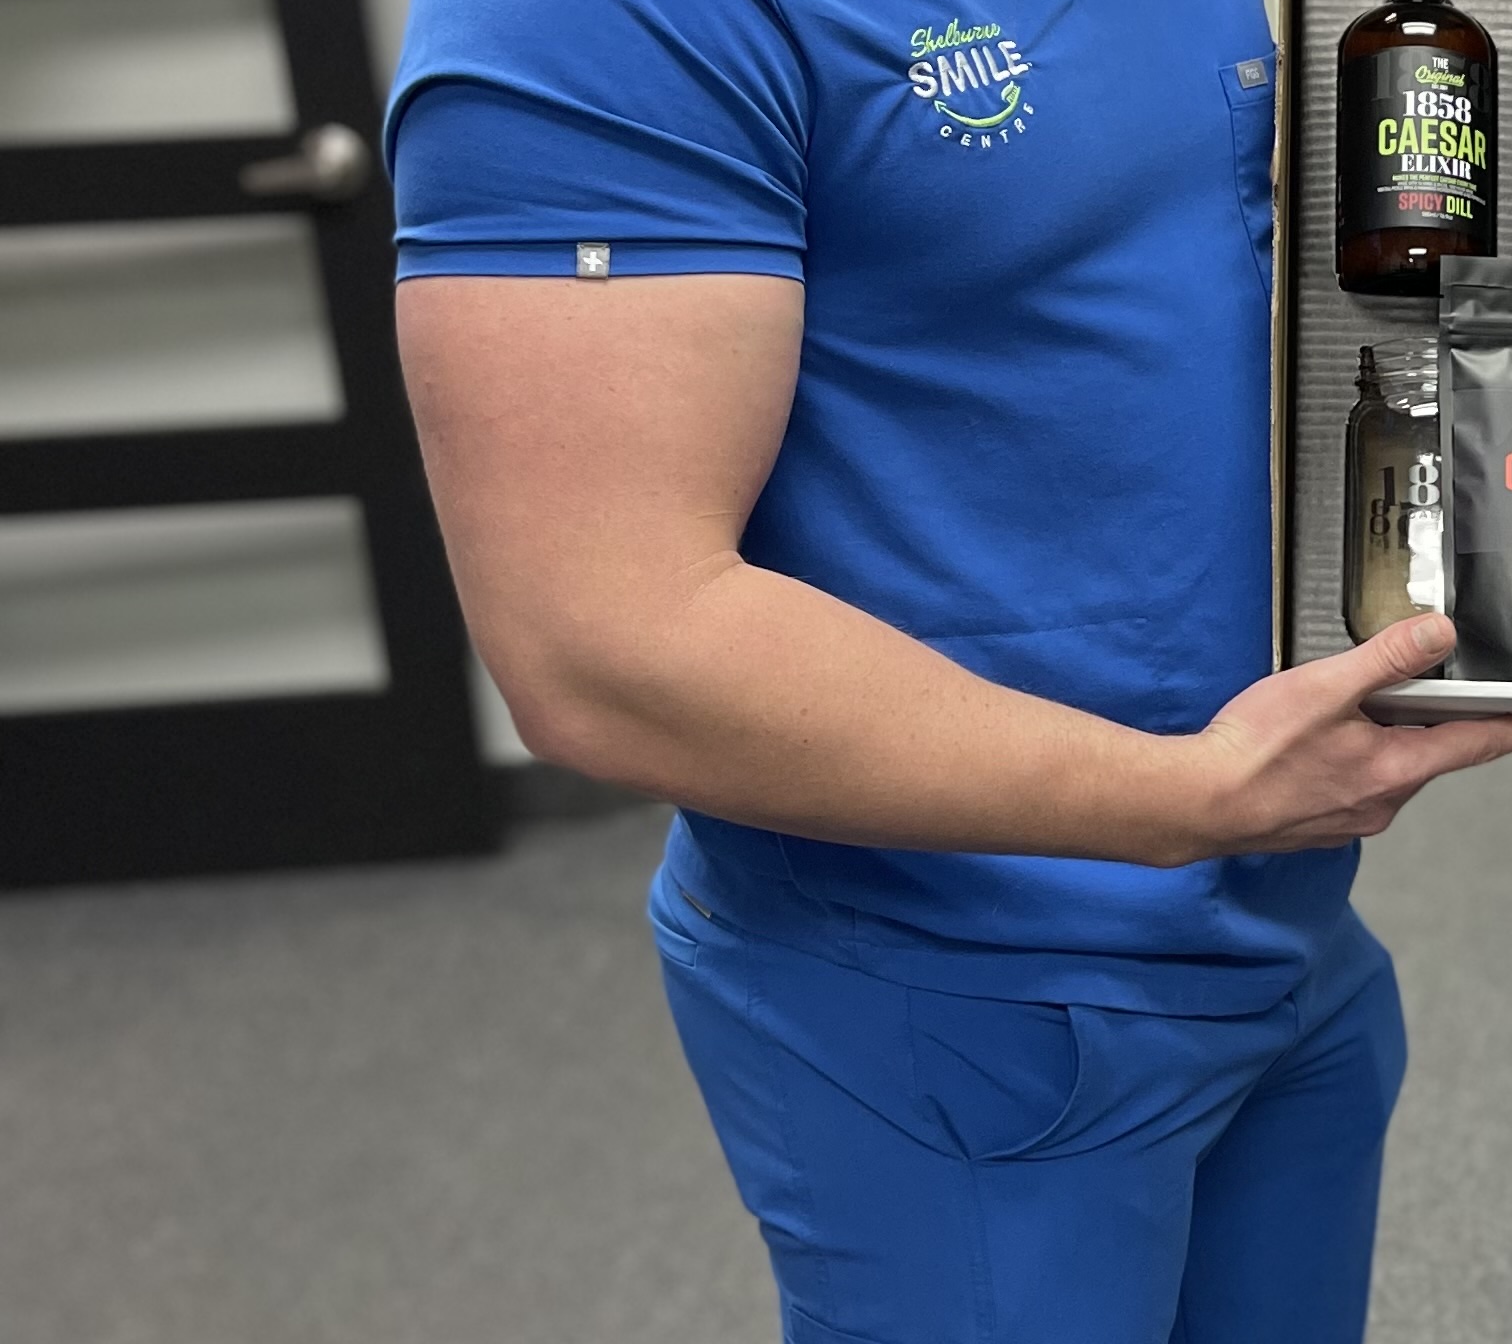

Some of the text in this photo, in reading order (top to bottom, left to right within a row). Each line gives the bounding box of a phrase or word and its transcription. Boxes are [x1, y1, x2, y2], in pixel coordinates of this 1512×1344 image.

[908, 41, 1029, 98] SMILE
[1415, 65, 1466, 87] Original
[1432, 56, 1449, 69] THE
[1402, 90, 1472, 124] 1858
[940, 102, 1034, 149] CENTRE
[1378, 117, 1486, 170] CAESAR
[1401, 154, 1472, 180] ELIXIR
[1398, 192, 1444, 211] SPICY
[1446, 195, 1473, 219] DILL
[1379, 463, 1441, 507] 18
